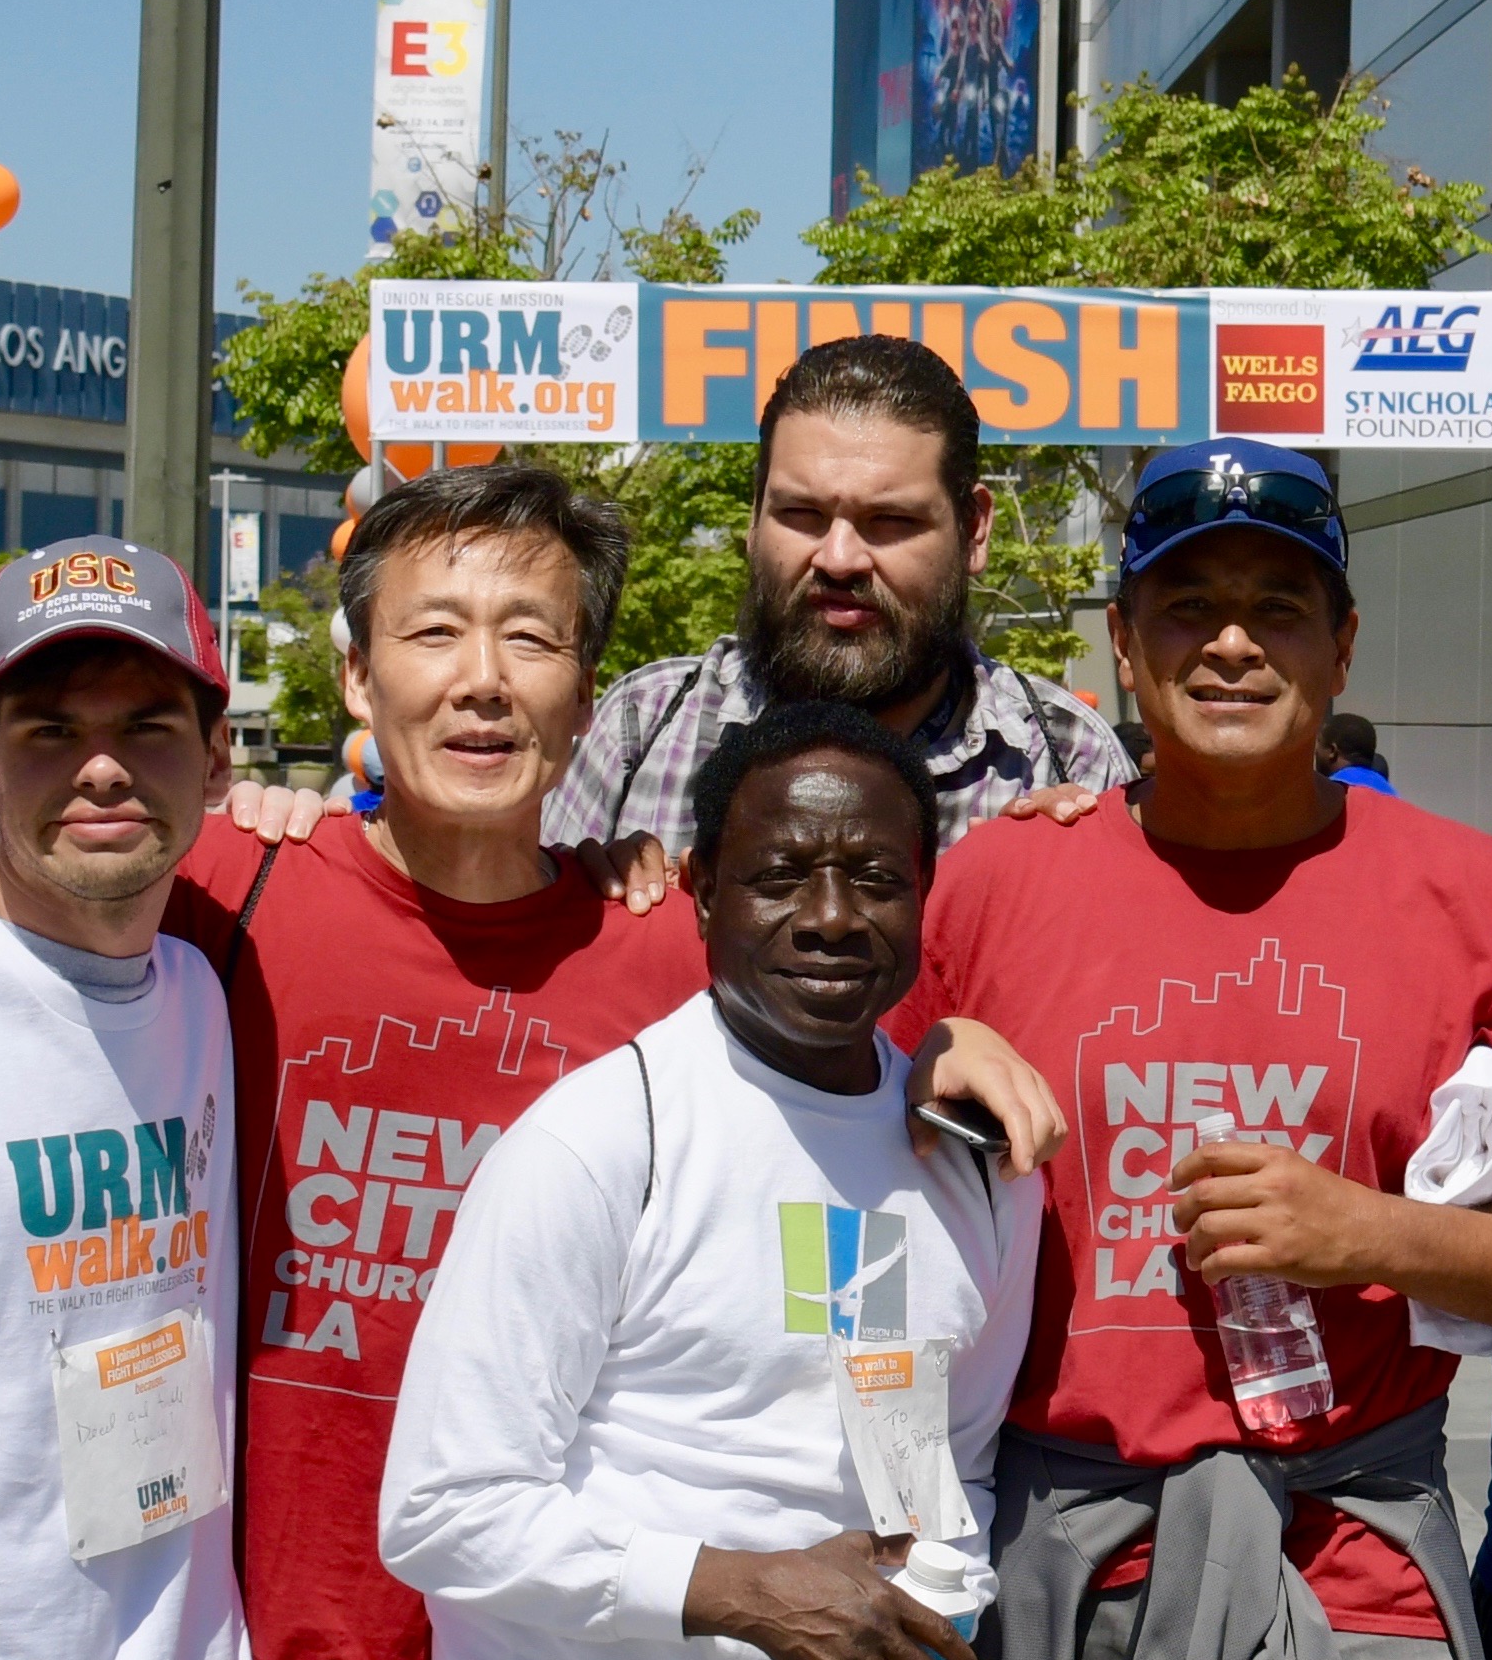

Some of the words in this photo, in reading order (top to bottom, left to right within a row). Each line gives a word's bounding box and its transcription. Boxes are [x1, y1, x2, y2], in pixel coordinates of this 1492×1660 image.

[391, 21, 470, 77] E3
[383, 292, 429, 306] UNION
[436, 293, 493, 307] RESCUE
[500, 294, 564, 307] MISSION
[1217, 300, 1299, 320] Sponsored
[383, 309, 562, 376] URM
[1361, 305, 1481, 354] AEG
[1221, 355, 1318, 376] WELLS
[390, 368, 616, 432] walk.org
[1224, 383, 1318, 403] FARGO
[389, 419, 407, 429] THE
[413, 419, 442, 429] WALK
[447, 419, 459, 429] TO
[464, 419, 494, 430] FIGHT
[499, 420, 588, 431] HOMELESSNESS
[30, 552, 136, 603] USC
[17, 603, 43, 622] 2017
[46, 593, 78, 610] ROSE
[82, 592, 116, 603] BOWL
[118, 594, 152, 611] GAME
[45, 601, 123, 619] CHAMPIONS
[1104, 1061, 1329, 1127] NEW
[6, 1116, 187, 1238] URM
[1094, 1244, 1185, 1300] LA
[28, 1300, 54, 1316] THE
[59, 1296, 86, 1312] WALK
[89, 1294, 103, 1306] TO
[105, 1288, 135, 1305] FIGHT
[261, 1291, 361, 1361] LA
[861, 1325, 891, 1337] VISION
[107, 1365, 132, 1383] FIGHT
[133, 1344, 182, 1374] HOMELESSNESS
[115, 1347, 141, 1366] joined
[865, 1358, 887, 1371] walk
[889, 1358, 897, 1369] to
[136, 1473, 178, 1511] URM
[141, 1494, 189, 1524] walk.org
